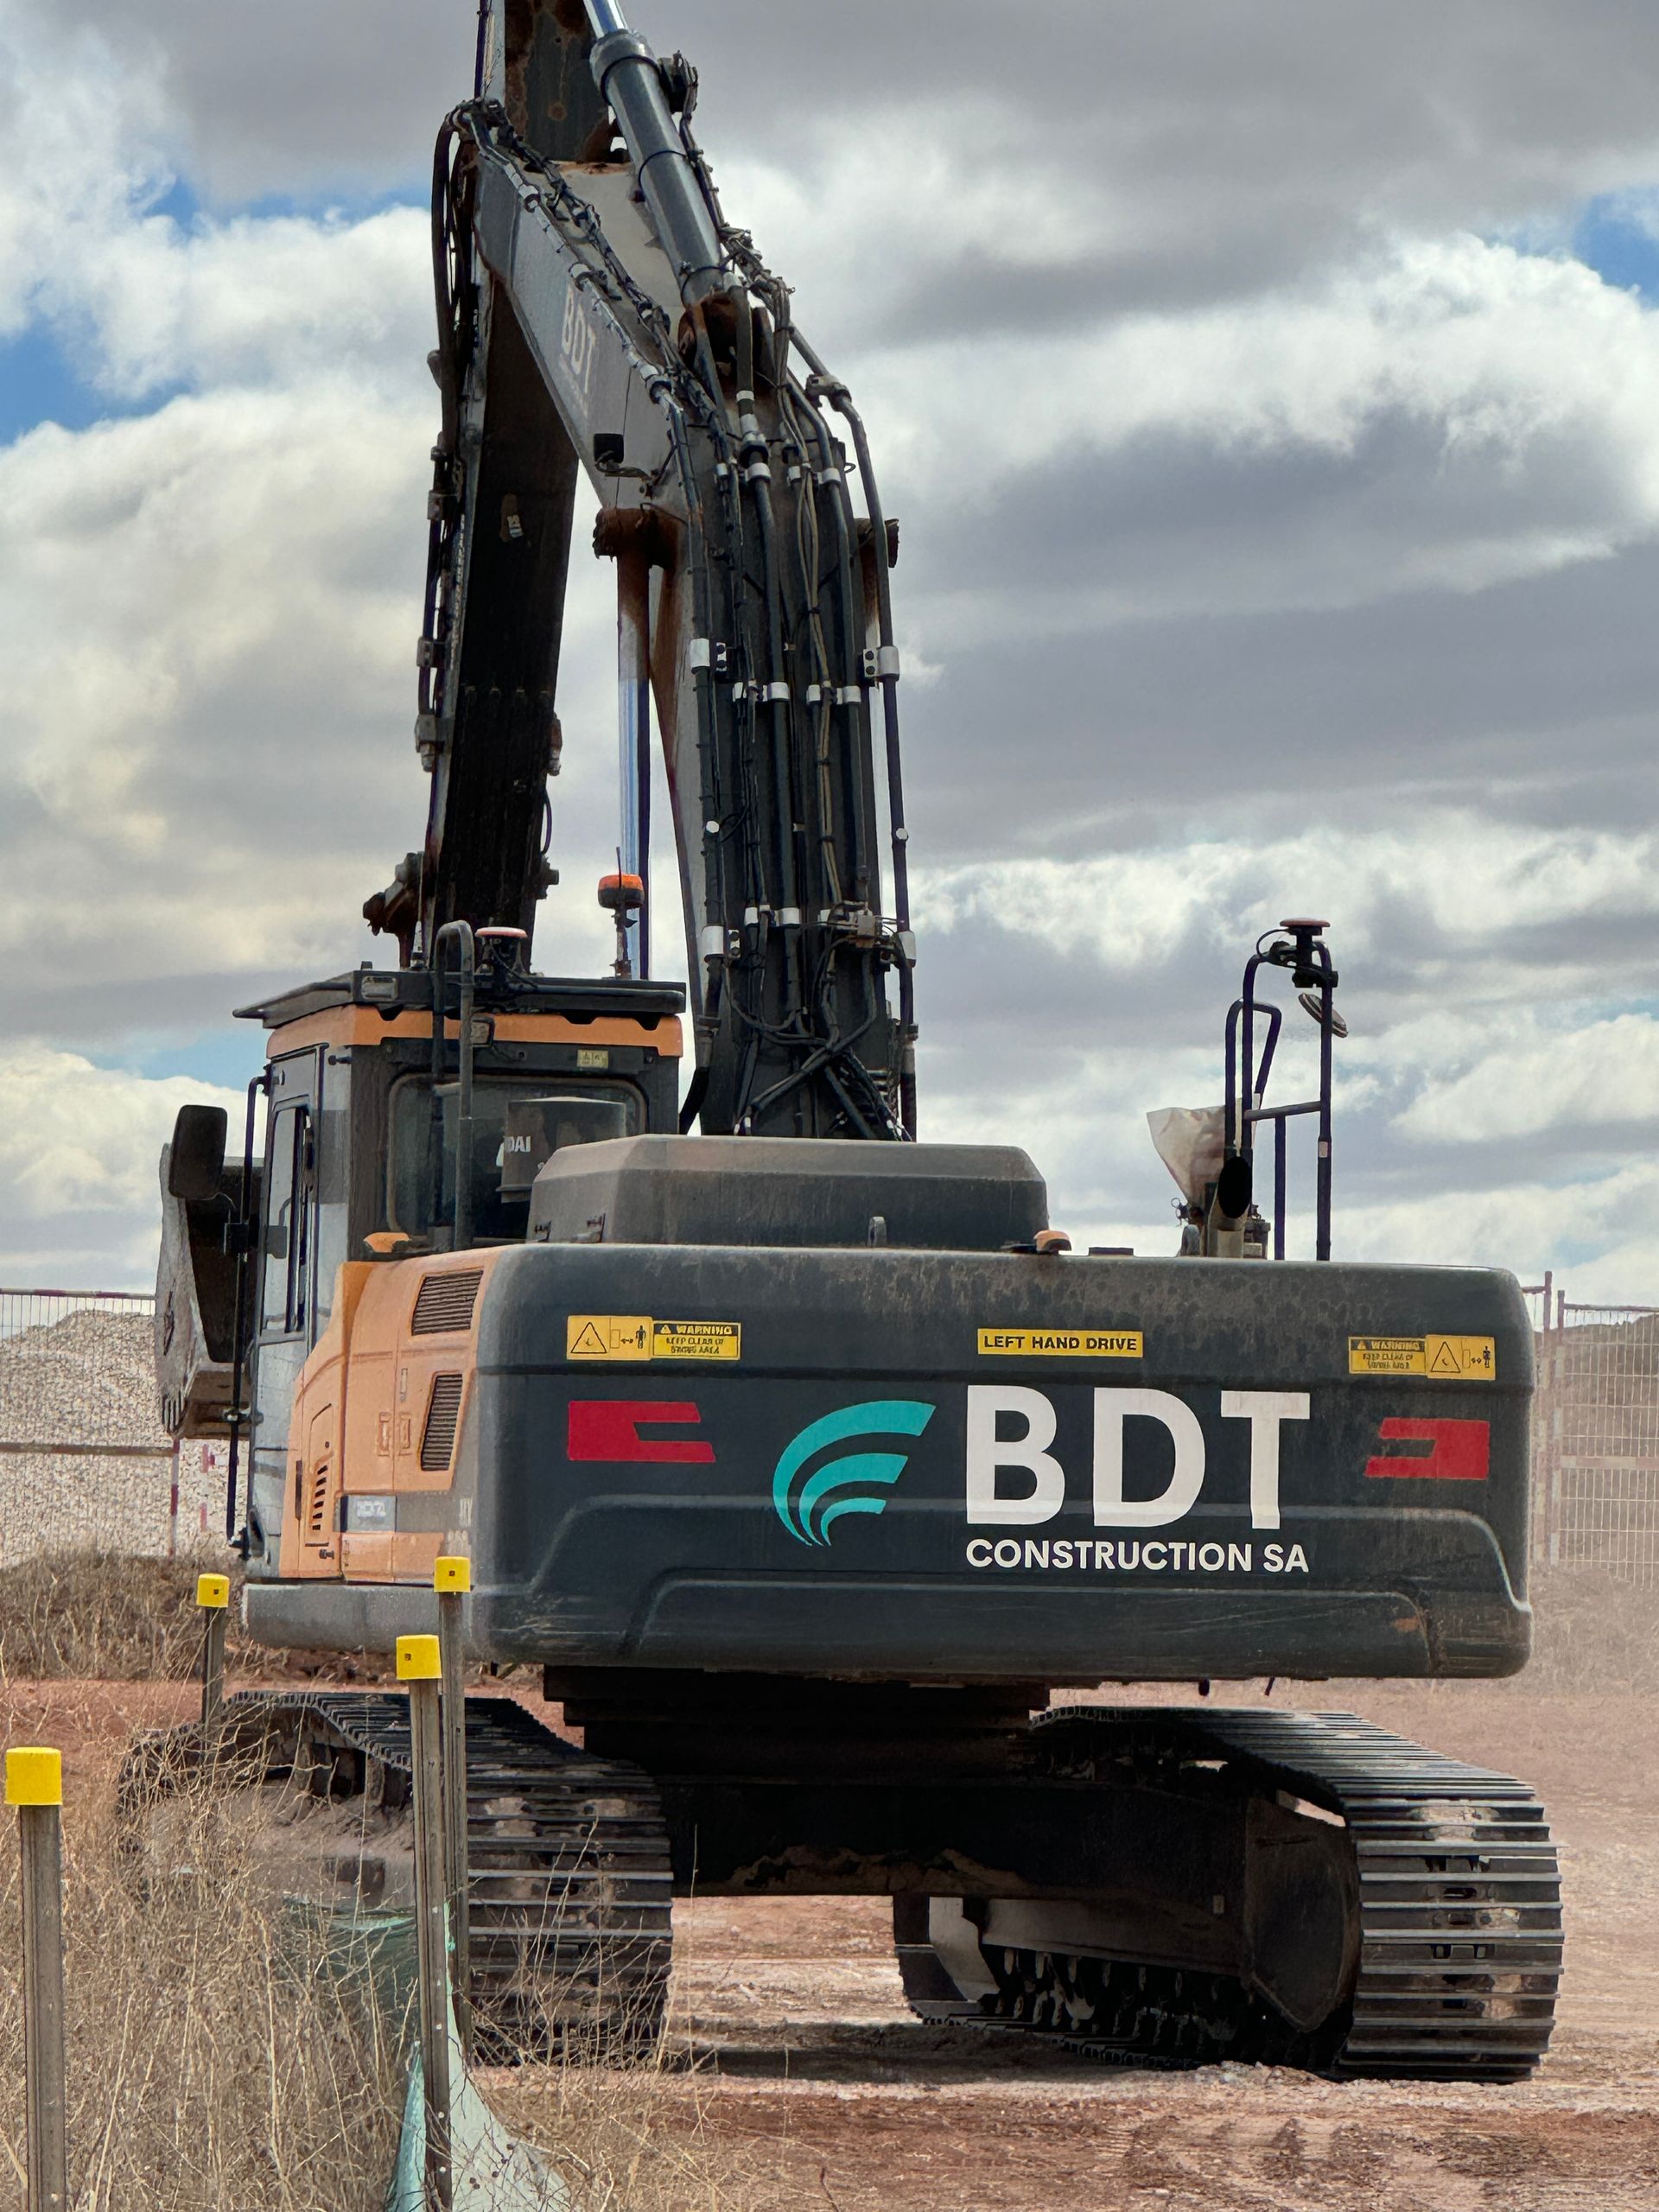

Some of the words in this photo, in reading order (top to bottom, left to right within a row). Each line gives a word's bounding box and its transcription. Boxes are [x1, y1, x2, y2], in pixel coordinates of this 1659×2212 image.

[562, 283, 596, 394] BDT
[677, 1325, 732, 1335] WARNING
[688, 1337, 713, 1345] CLEAR
[983, 1335, 1026, 1349] LEFT
[1032, 1336, 1080, 1350] HAND
[1085, 1337, 1137, 1351] DRIVE
[1371, 1340, 1420, 1351] WARNING
[966, 1384, 1311, 1529] BDT
[965, 1538, 1252, 1573] CONSTRUCTION
[1263, 1542, 1310, 1573] SA
